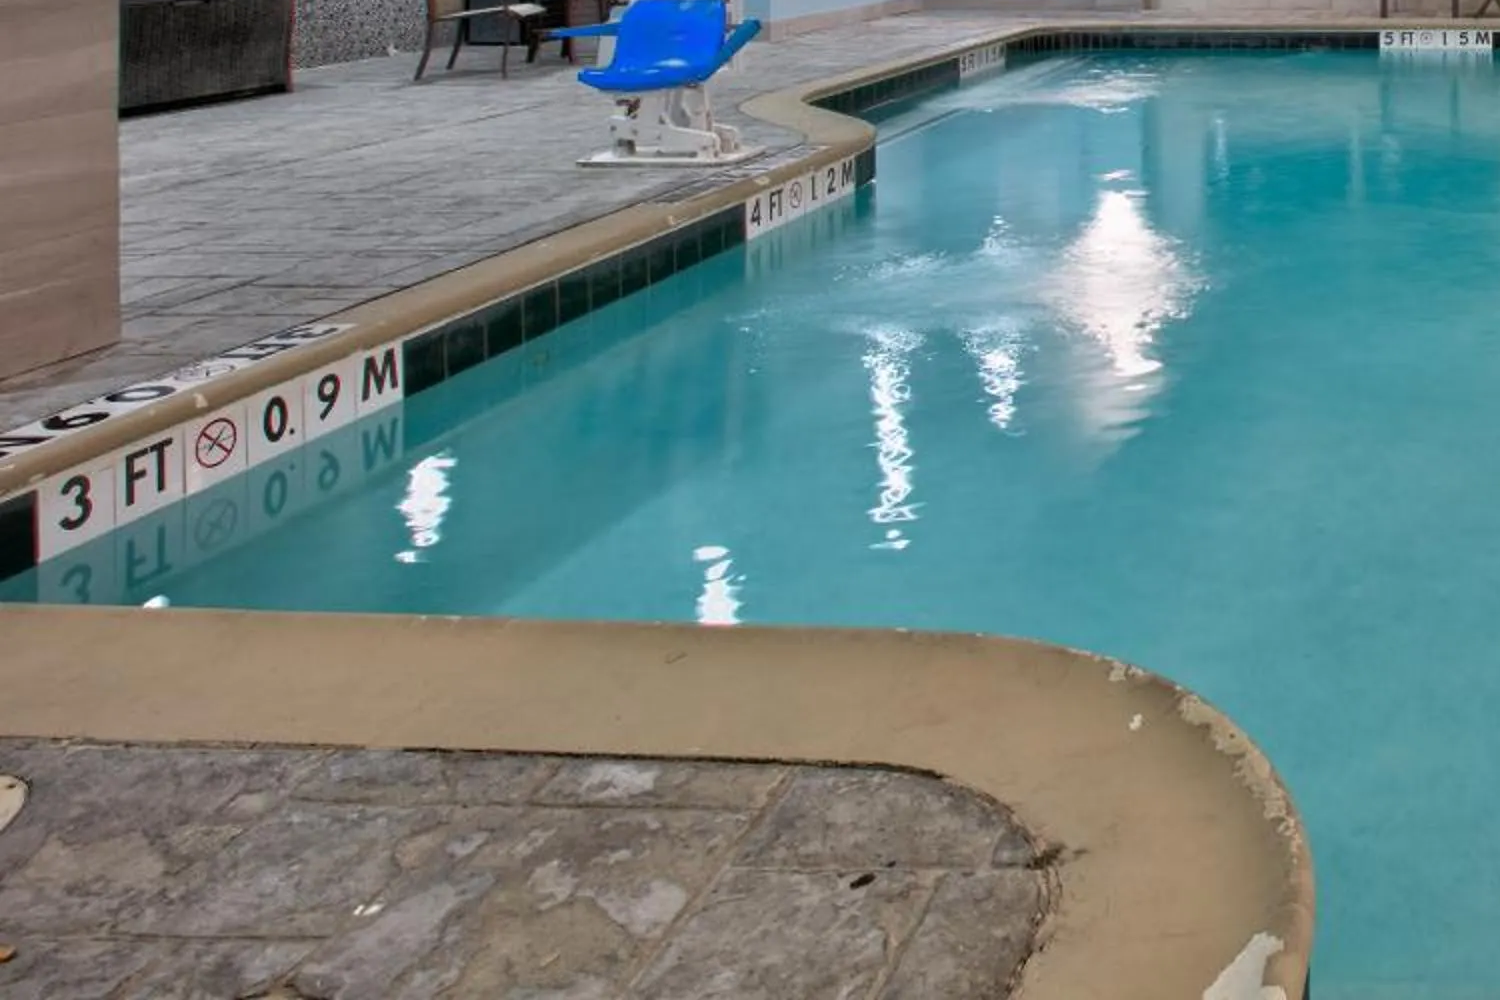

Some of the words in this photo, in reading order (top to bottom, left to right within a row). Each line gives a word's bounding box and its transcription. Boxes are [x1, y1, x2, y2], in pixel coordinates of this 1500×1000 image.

[1384, 31, 1394, 46] 5
[1401, 31, 1414, 46] FT
[1475, 31, 1490, 45] M
[751, 197, 762, 227] 4
[769, 188, 783, 221] FT
[58, 475, 93, 531] 3
[125, 437, 173, 506] FT
[362, 348, 399, 401] M
